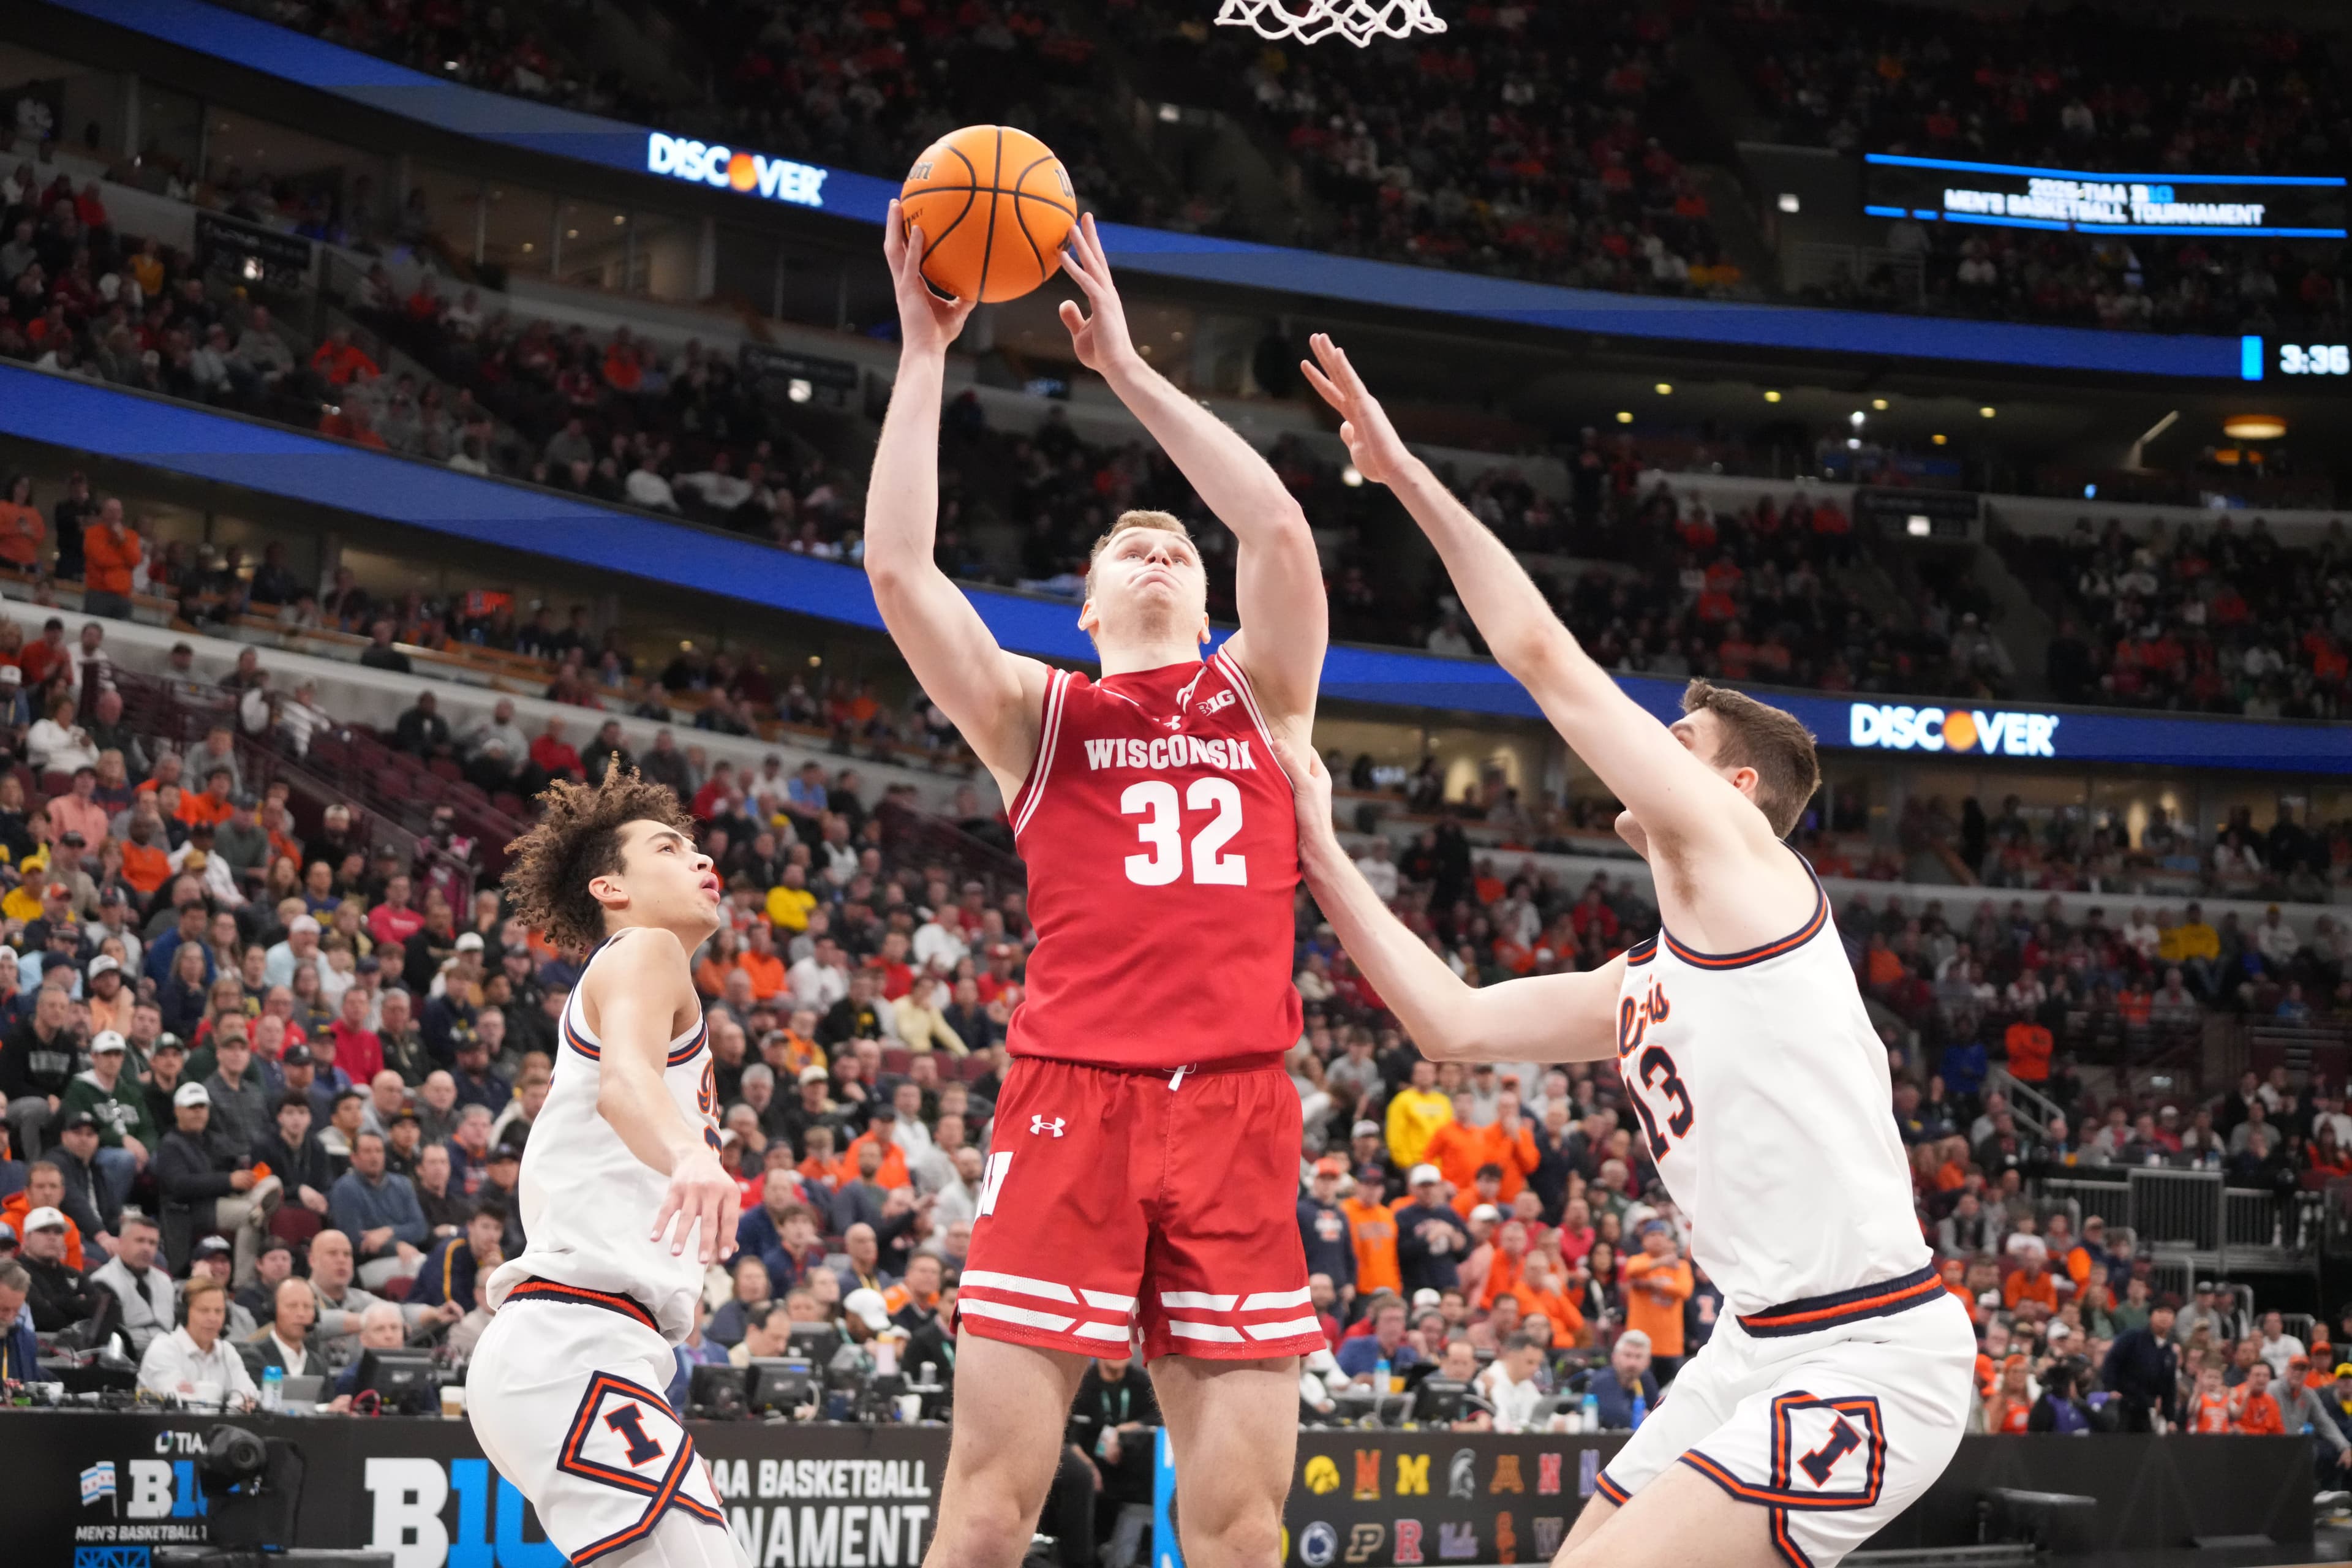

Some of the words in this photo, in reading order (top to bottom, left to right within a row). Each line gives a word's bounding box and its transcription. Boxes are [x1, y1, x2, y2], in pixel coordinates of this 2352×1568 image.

[648, 132, 826, 207] DISCOVER
[2007, 192, 2128, 224] BASKETBALL
[2130, 203, 2265, 225] TOURNAMENT
[2280, 344, 2350, 375] 3:36
[1850, 703, 2058, 757] DISCOVER
[1121, 777, 1248, 887] 32
[1626, 1045, 1694, 1164] 13
[175, 1431, 208, 1454] TIA
[757, 1459, 932, 1499] BASKETBALL
[1396, 1453, 1430, 1495] M
[75, 1525, 117, 1541] MEN'S
[118, 1525, 199, 1541] BASKETBALL
[1344, 1523, 1385, 1563] P
[1393, 1518, 1424, 1565] R
